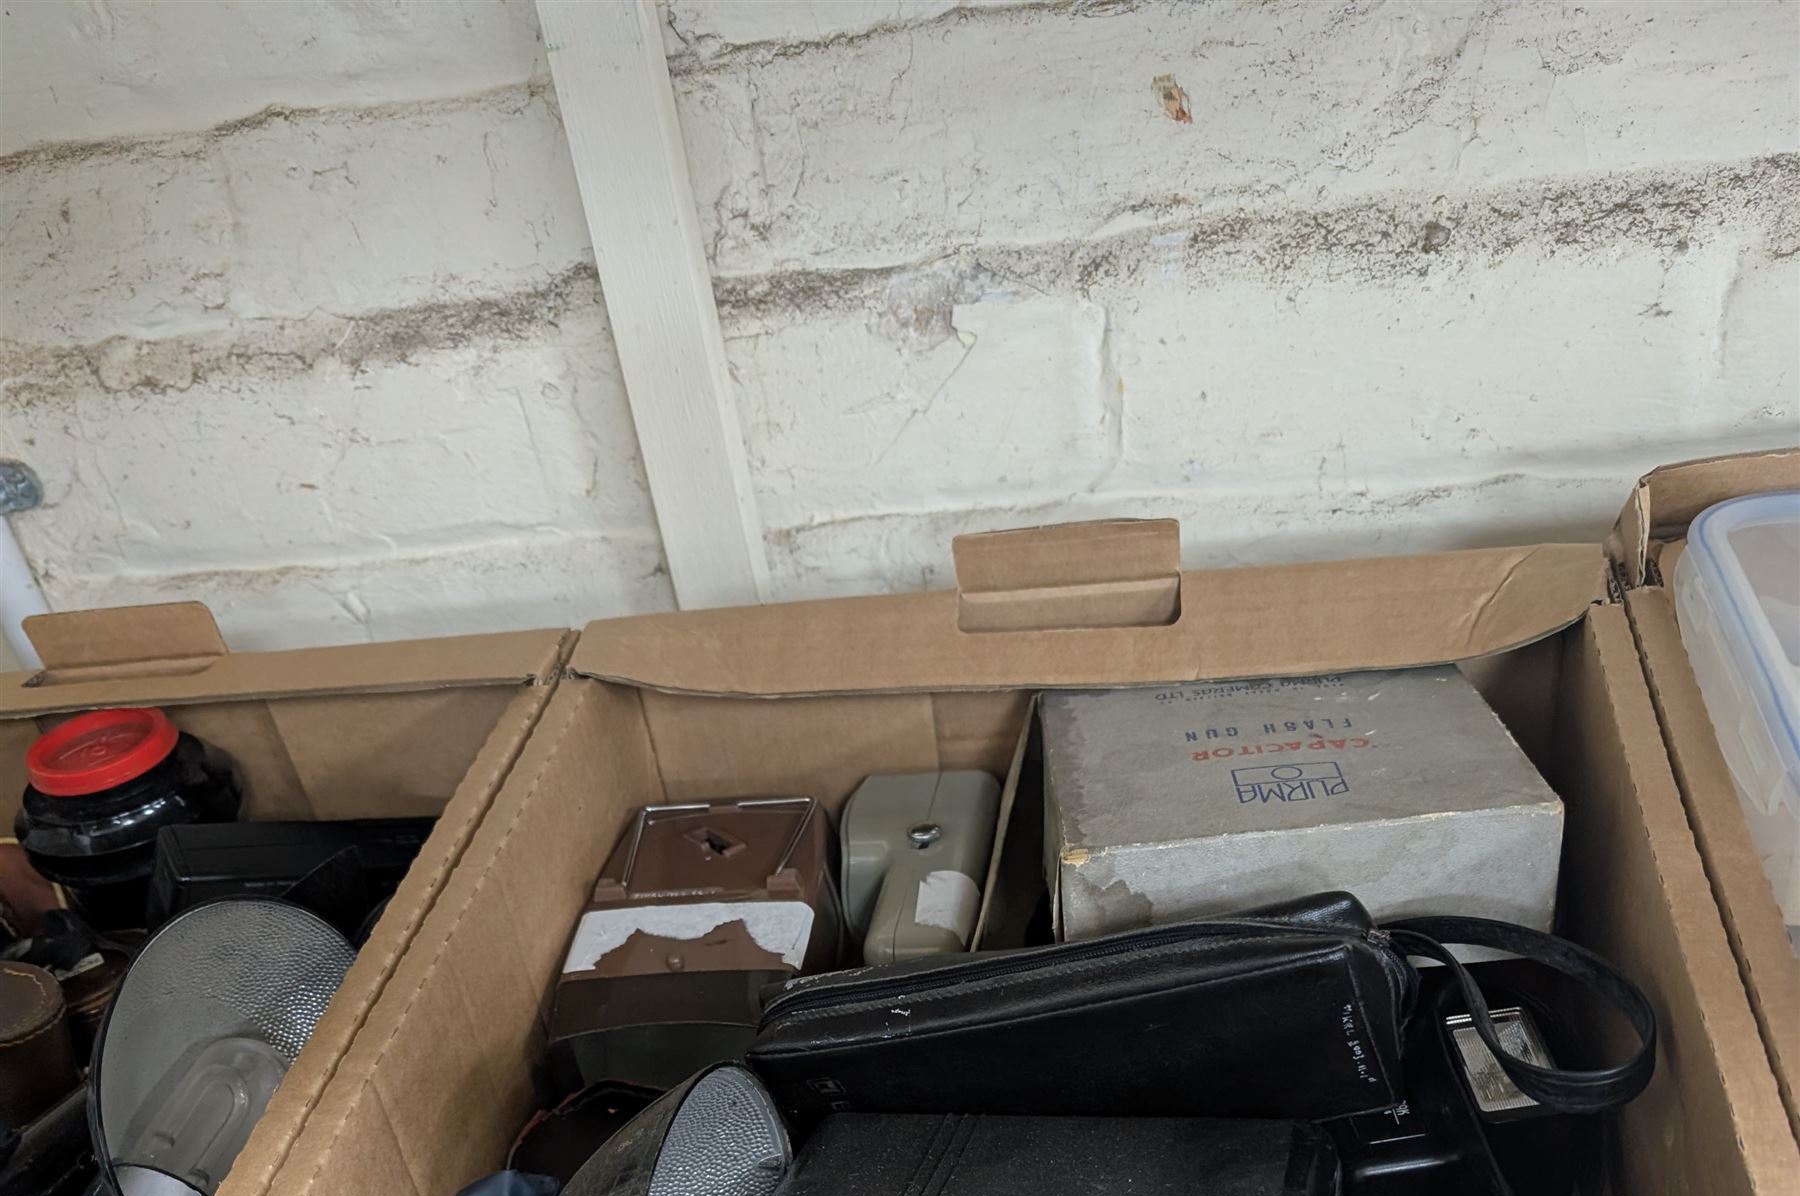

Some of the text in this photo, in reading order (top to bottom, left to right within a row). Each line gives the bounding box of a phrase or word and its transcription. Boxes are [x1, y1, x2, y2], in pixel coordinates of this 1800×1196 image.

[1185, 717, 1353, 742] FLASH GUN
[1191, 737, 1370, 762] CAPACITOR
[1237, 777, 1350, 804] PURMA
